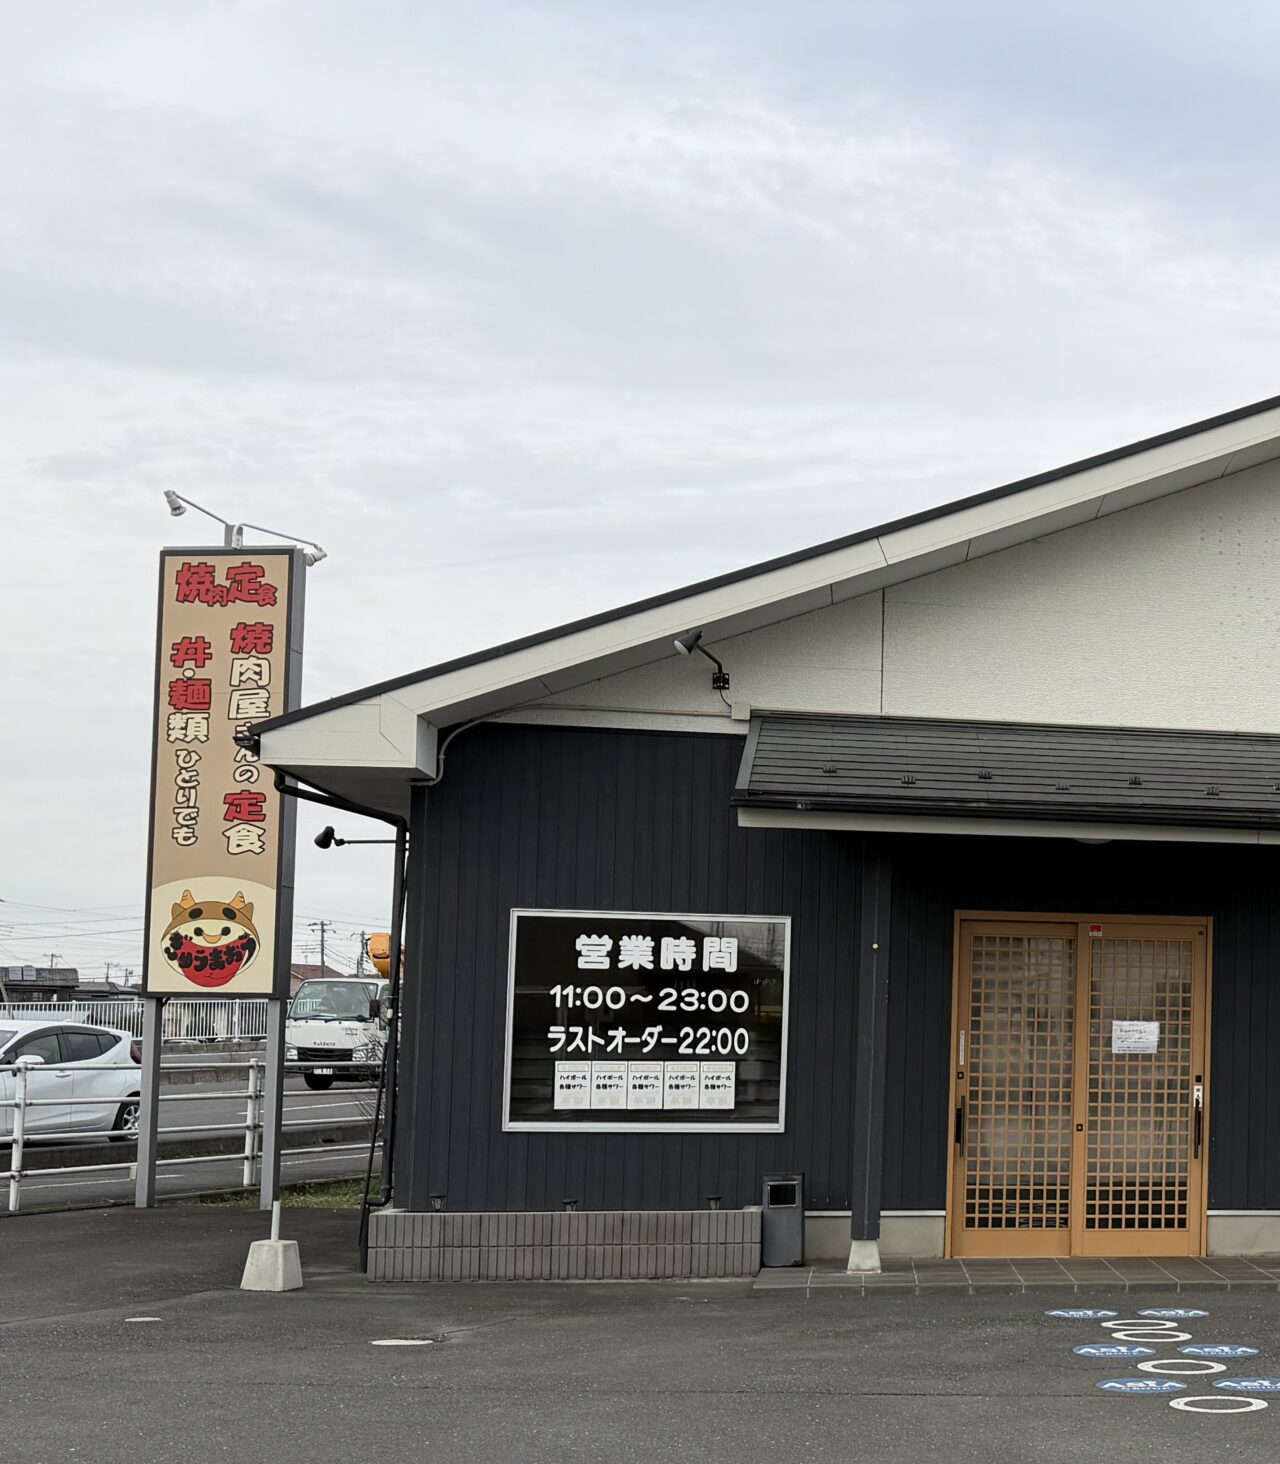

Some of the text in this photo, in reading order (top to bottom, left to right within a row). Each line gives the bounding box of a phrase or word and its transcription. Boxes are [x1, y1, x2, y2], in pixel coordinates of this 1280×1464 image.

[175, 562, 278, 607] 焼肉定食
[172, 748, 202, 847] ひとりでも
[576, 935, 738, 972] 営業時間
[548, 1025, 748, 1054] ラストオーダー22:00
